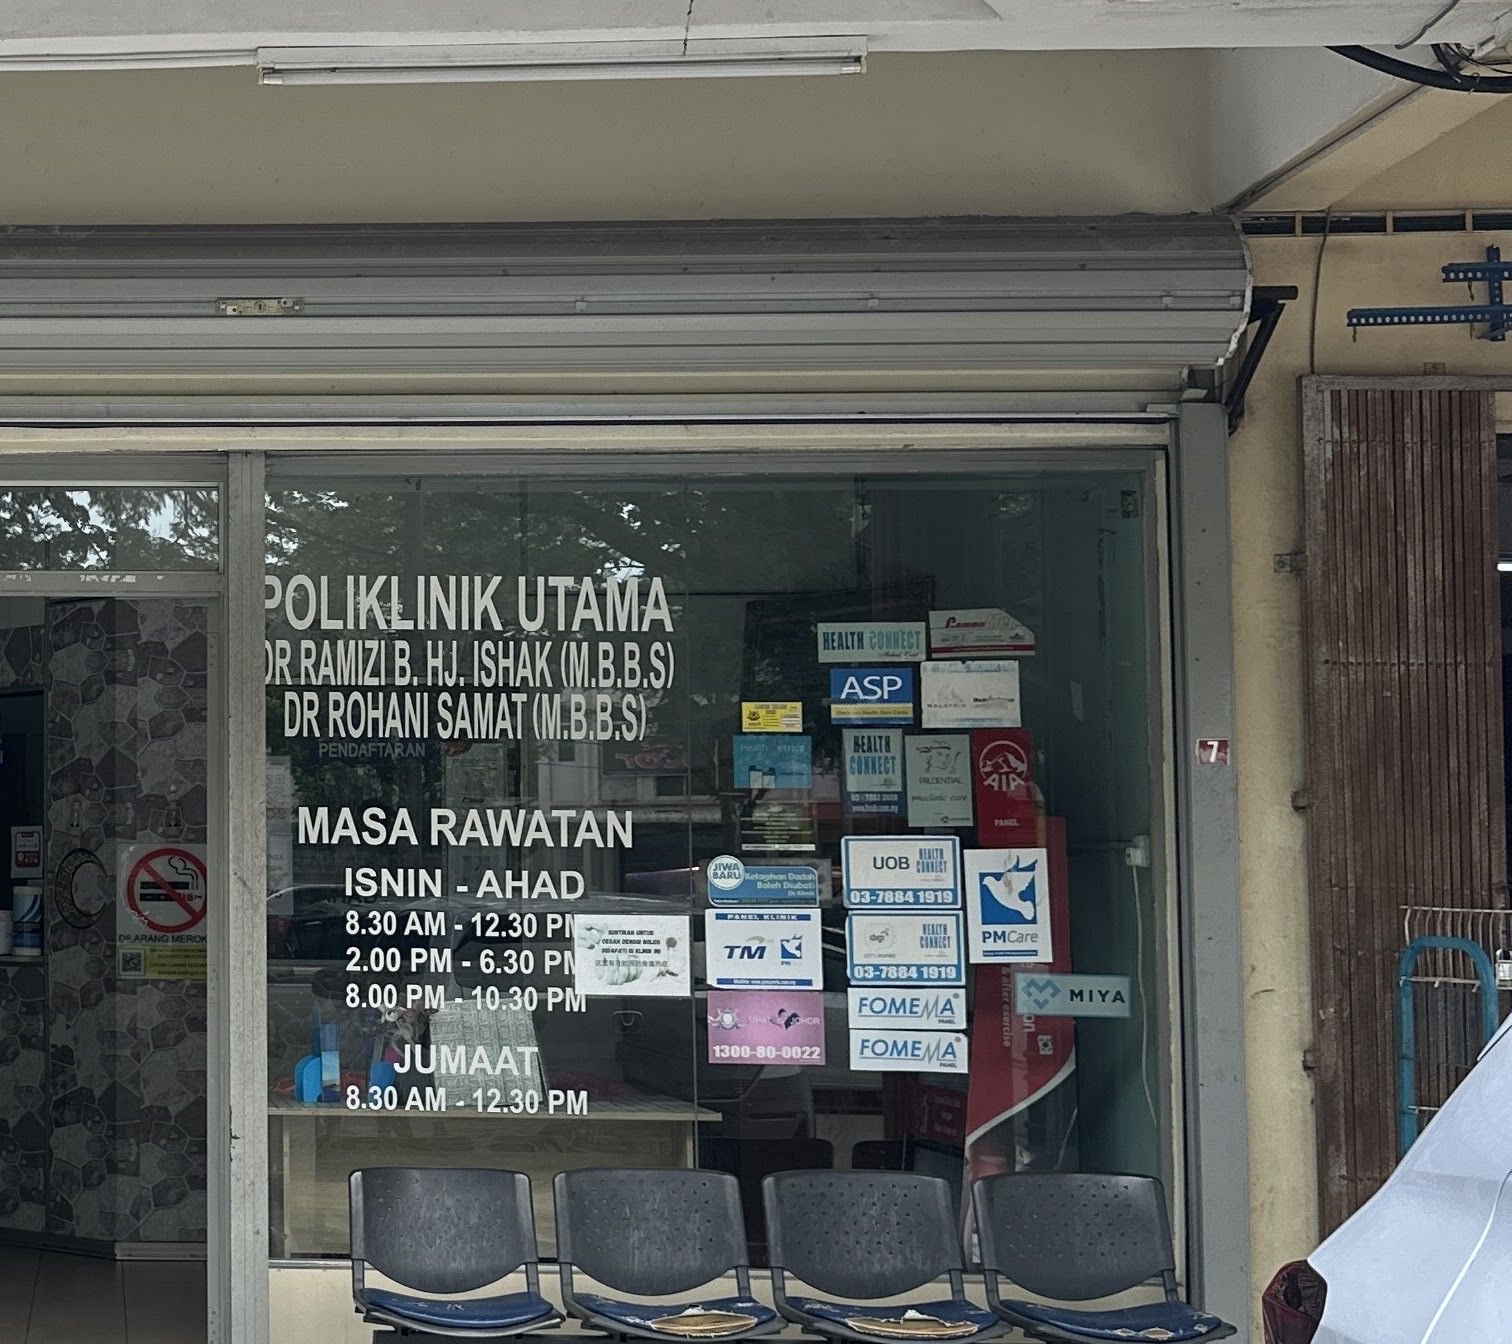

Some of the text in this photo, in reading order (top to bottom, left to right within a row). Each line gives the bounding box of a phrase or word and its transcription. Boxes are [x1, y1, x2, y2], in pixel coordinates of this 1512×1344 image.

[265, 574, 674, 632] POLIKLINIK UTAMA
[823, 631, 864, 651] HEALTH
[870, 630, 921, 650] CONNECT
[301, 640, 386, 686] RAMIZI
[395, 640, 418, 686] B.
[427, 640, 465, 687] HJ.
[473, 641, 553, 688] ISHAK
[560, 641, 674, 689] (M.B.B.S)
[841, 676, 902, 700] ASP
[284, 691, 646, 741] DR ROHANI SAMAT (M.B.B.S)
[319, 742, 425, 757] PENDAFTARAN
[853, 736, 891, 753] HEALTH
[1207, 741, 1218, 762] 7
[850, 756, 896, 775] CONNECT
[982, 774, 1025, 792] AIA
[298, 806, 633, 848] MASA RAWATAN
[994, 819, 1019, 827] PANEL
[919, 848, 944, 860] HEALTH
[713, 862, 740, 871] JIWA
[873, 856, 910, 870] UOB
[916, 861, 947, 873] CONNECT
[345, 867, 442, 898] ISNIN
[476, 869, 585, 899] AHAD
[713, 871, 741, 880] BARU
[917, 891, 952, 903] 1919
[345, 912, 397, 936] 8.30
[404, 912, 446, 936] AM
[471, 912, 538, 937] 12.30
[922, 924, 948, 935] HEALTH
[119, 934, 207, 943] DILARANG MEROK
[920, 936, 951, 949] CONNECT
[982, 930, 1038, 944] PMCare
[345, 947, 402, 972] 2.00
[410, 948, 452, 973] PM
[479, 949, 534, 974] 6.30
[724, 946, 766, 959] TM
[921, 966, 956, 978] 1919
[345, 984, 397, 1008] 8.00
[405, 984, 445, 1009] PM
[471, 985, 538, 1011] 10.30
[546, 987, 587, 1012] PM
[1069, 989, 1125, 1003] MIYA
[858, 994, 954, 1020] FOMEMA
[393, 1045, 539, 1075] JUMAAT
[713, 1045, 821, 1059] 1300-80-0022
[860, 1039, 956, 1064] FOMEMA
[345, 1085, 398, 1110] 8.30
[405, 1086, 446, 1111] AM
[472, 1088, 539, 1113] 12.30
[548, 1089, 588, 1116] PM
